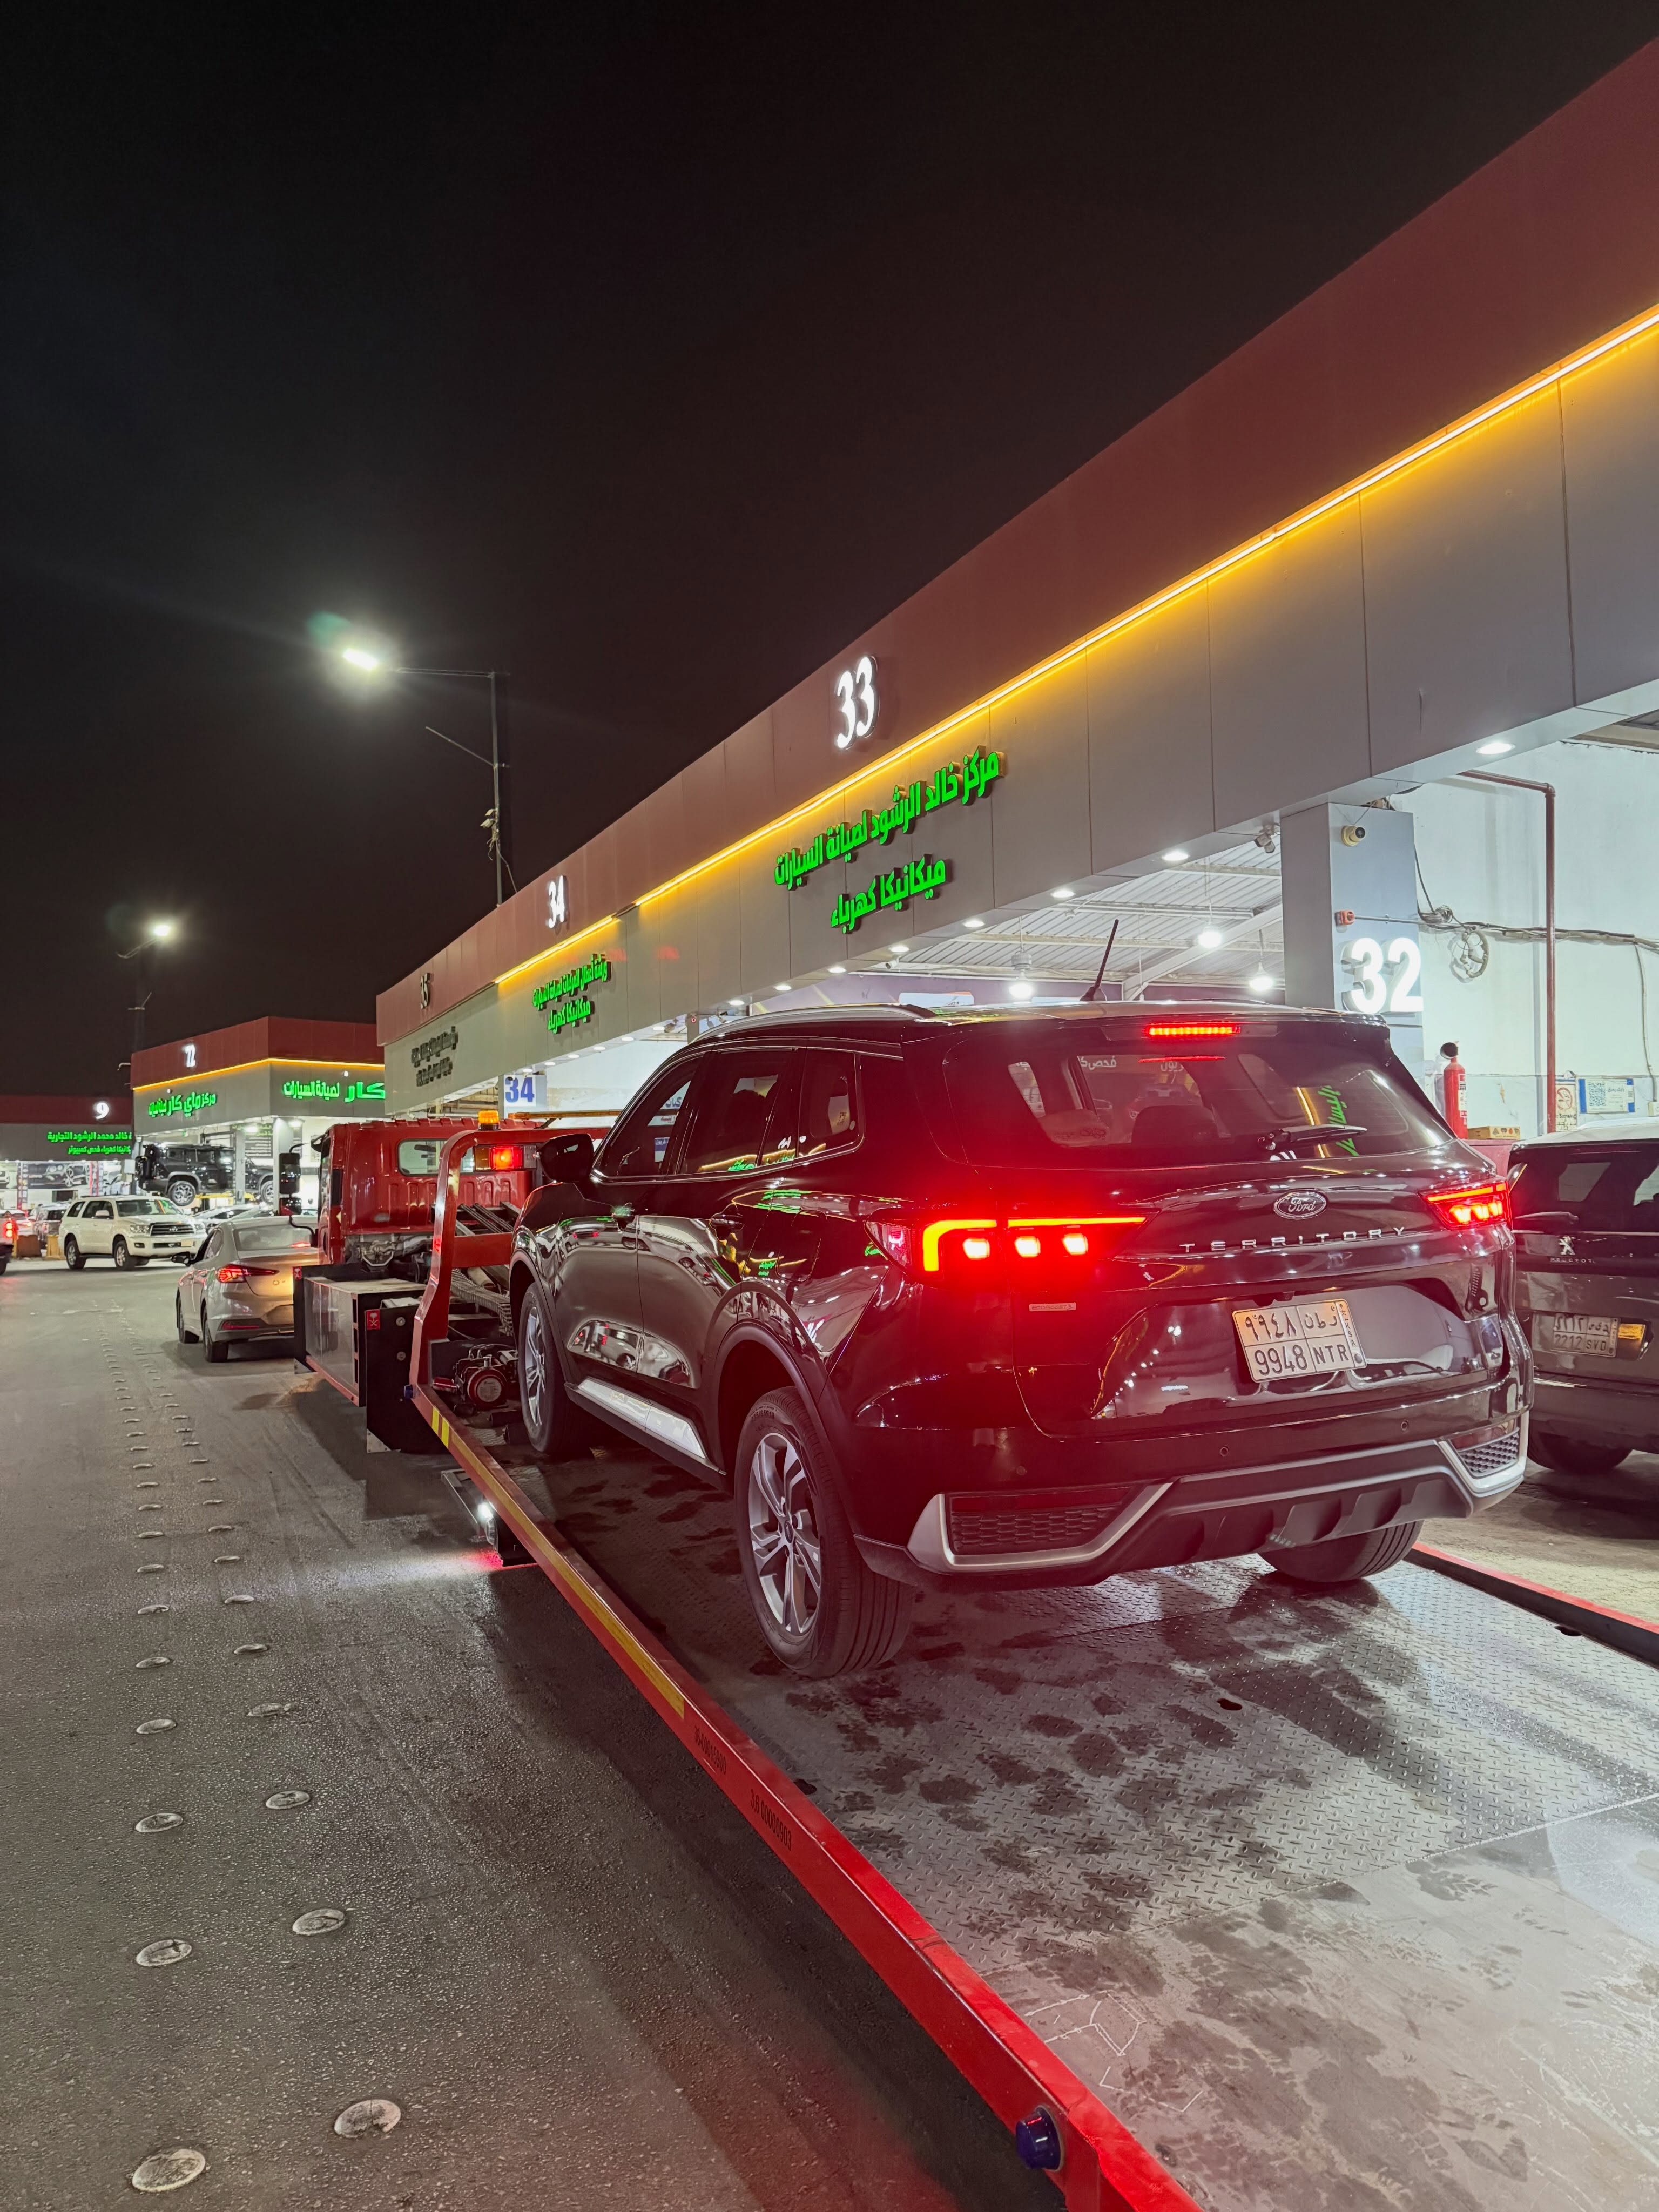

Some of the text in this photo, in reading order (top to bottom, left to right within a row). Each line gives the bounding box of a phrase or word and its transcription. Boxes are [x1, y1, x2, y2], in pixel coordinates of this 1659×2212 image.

[837, 656, 878, 750] 33
[774, 748, 1000, 890] مركز خالد الرشود لصيانة السيارات
[548, 875, 565, 928] 34
[831, 856, 946, 934] ميكانيكا كهرباء
[1348, 937, 1424, 1014] 32
[420, 973, 430, 1009] 35
[548, 997, 591, 1034] ميكانيكا كهرباء
[201, 1092, 216, 1107] مركز
[283, 1080, 386, 1102] كار لصيانة السيارات
[505, 1077, 535, 1103] 34
[96, 1102, 109, 1120] 9
[167, 1095, 183, 1116] كار
[184, 1092, 201, 1117] ماي
[47, 1131, 73, 1142] التجارية
[73, 1130, 97, 1142] الرشود
[114, 1131, 128, 1140] خالد
[1287, 1197, 1316, 1213] Ford
[1179, 1227, 1405, 1253] TERRITORY
[1555, 1334, 1582, 1350] 2212
[1586, 1339, 1607, 1351] SVD
[1254, 1344, 1308, 1376] 9948
[1313, 1344, 1349, 1364] NTR
